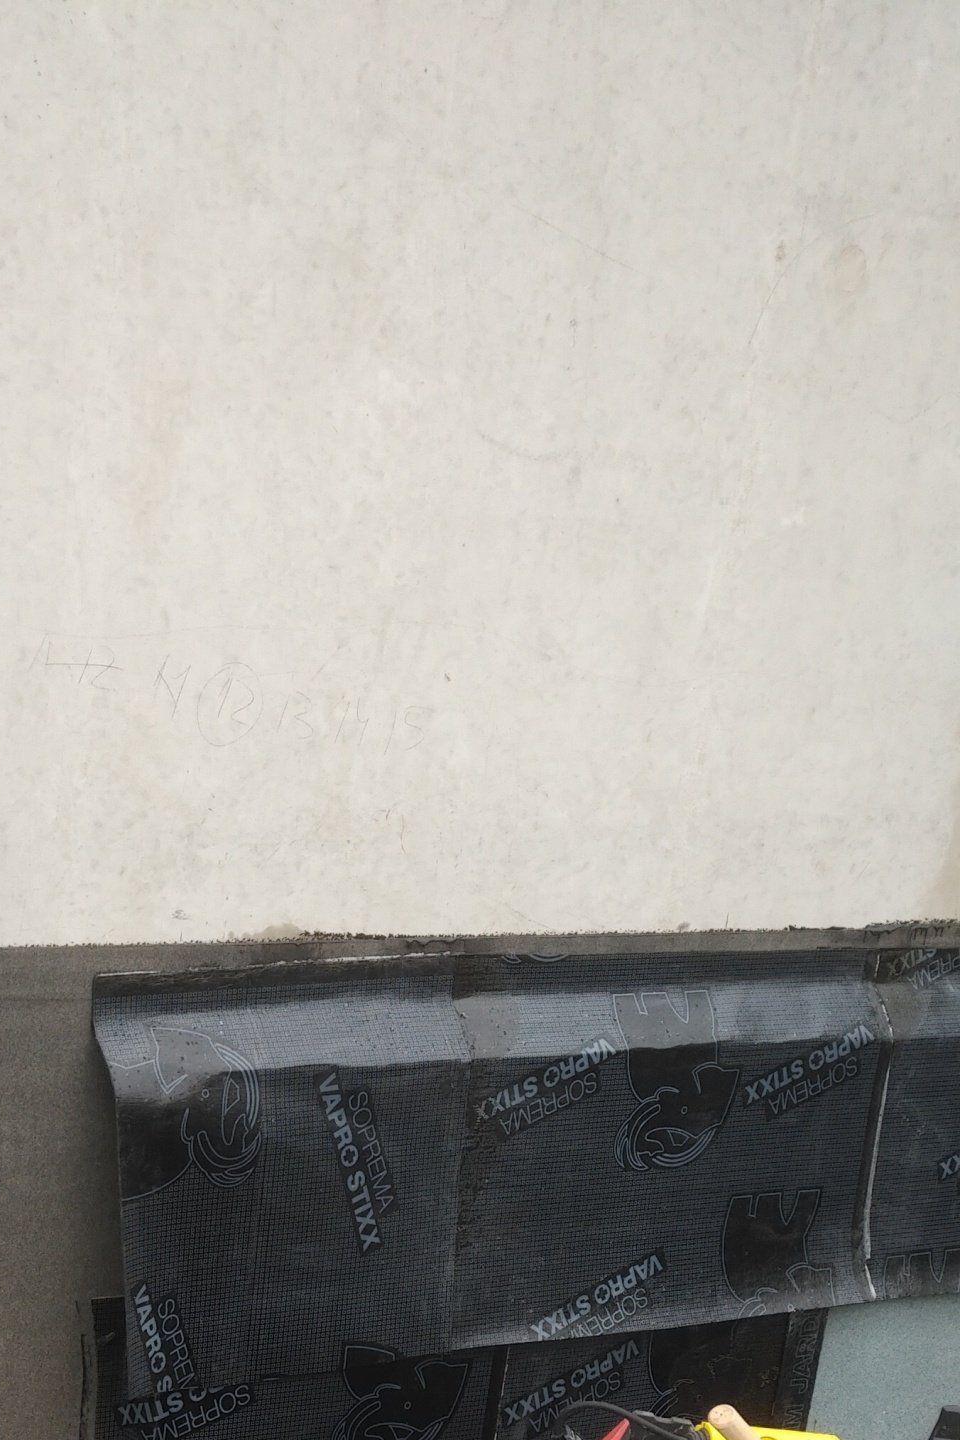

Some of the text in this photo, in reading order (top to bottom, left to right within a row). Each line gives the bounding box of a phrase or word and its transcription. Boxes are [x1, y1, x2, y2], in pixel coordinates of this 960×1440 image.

[475, 1037, 617, 1121] VAPRO STIXX
[500, 1071, 597, 1135] SOPREMA
[744, 1025, 875, 1105] VAPRO STIXX
[770, 1056, 858, 1114] SOPREMA
[319, 1073, 380, 1252] VAPRO STIXX
[349, 1091, 394, 1213] SOPREMA
[133, 1283, 167, 1375] VAPRO
[529, 1254, 664, 1341] VAPRO STIXX
[570, 1287, 648, 1337] SOPREM
[158, 1298, 205, 1390] SOPREM
[503, 1340, 640, 1426] VAPRO STIXX
[118, 1391, 184, 1427] STIXX
